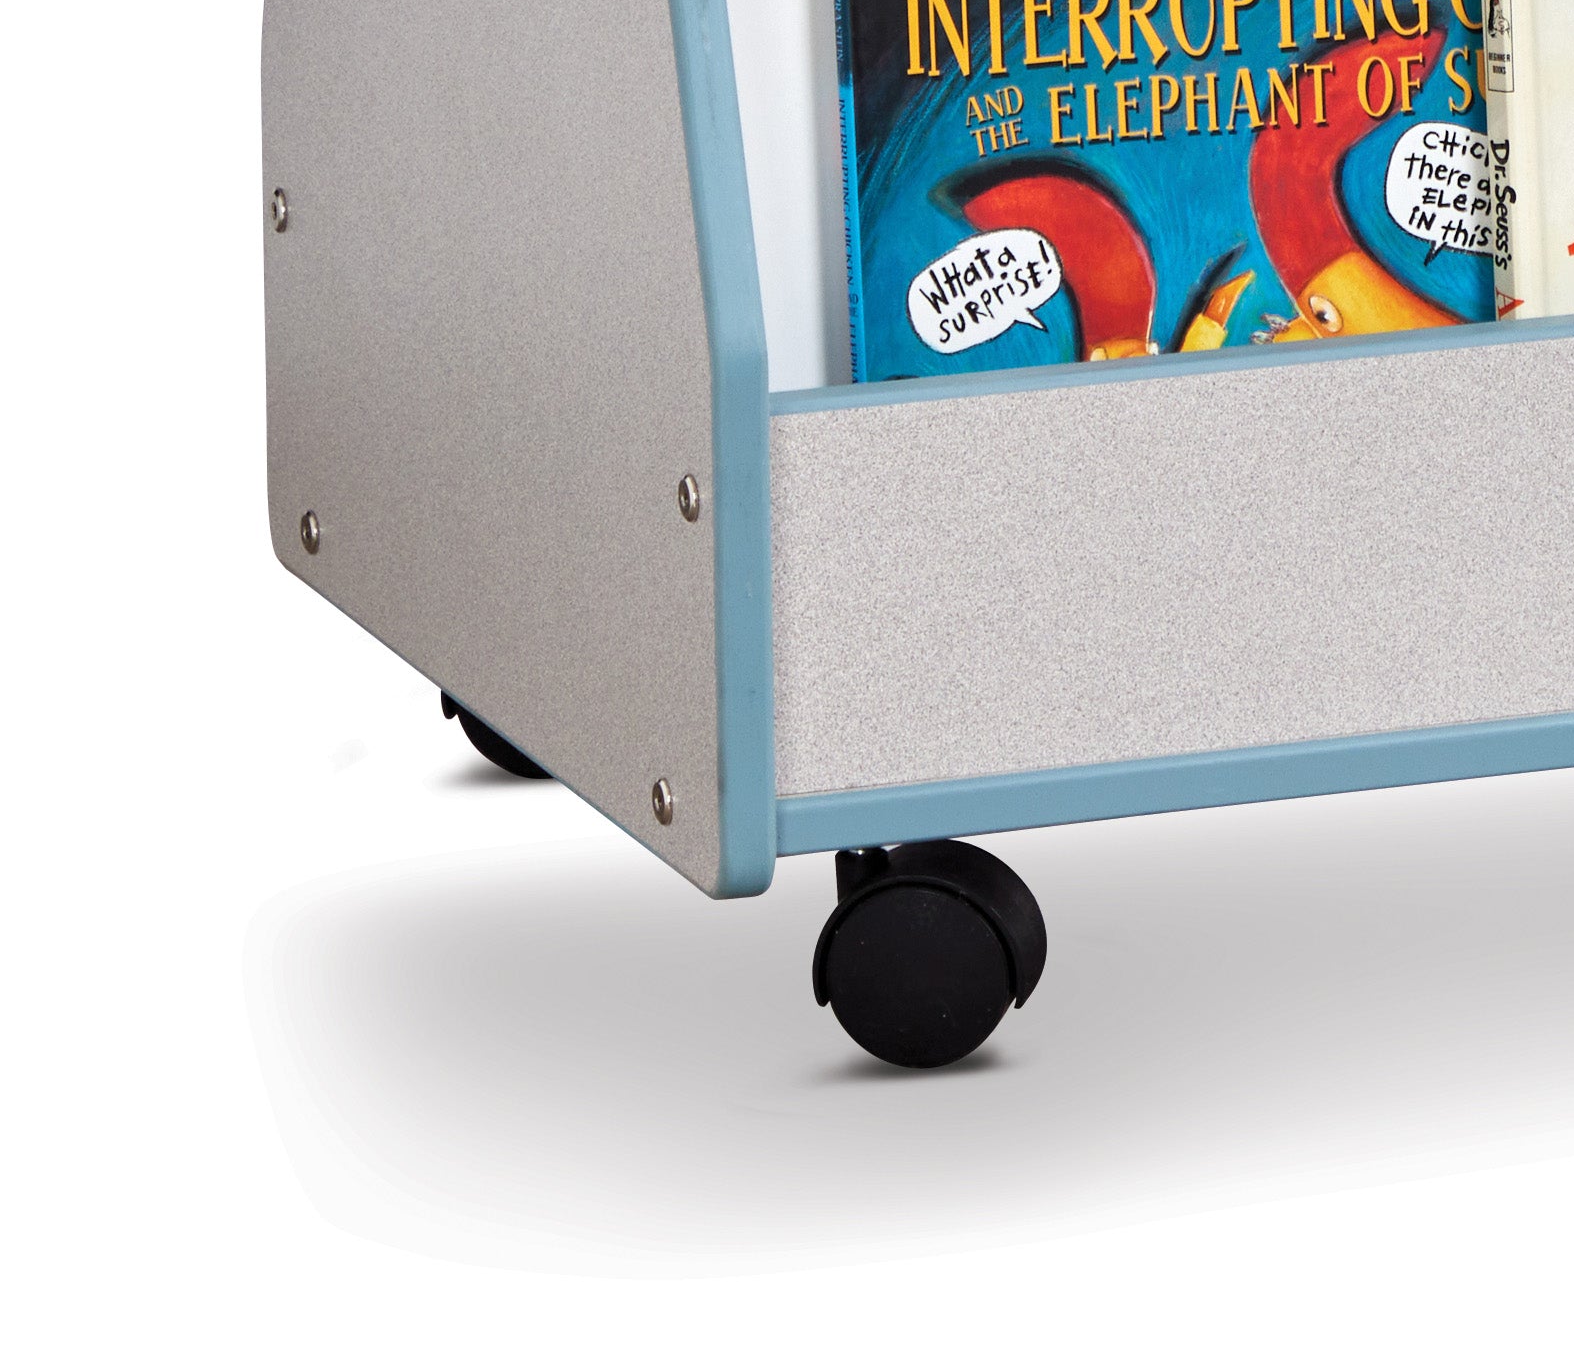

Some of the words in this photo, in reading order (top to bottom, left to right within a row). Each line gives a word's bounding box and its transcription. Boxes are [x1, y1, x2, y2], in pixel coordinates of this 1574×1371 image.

[964, 87, 1026, 126] AND
[1049, 62, 1338, 147] ELEPHANT
[1356, 48, 1425, 119] OF
[970, 122, 1029, 158] THE
[1490, 139, 1510, 181] Dr.
[1441, 219, 1493, 247] this
[998, 246, 1017, 267] a
